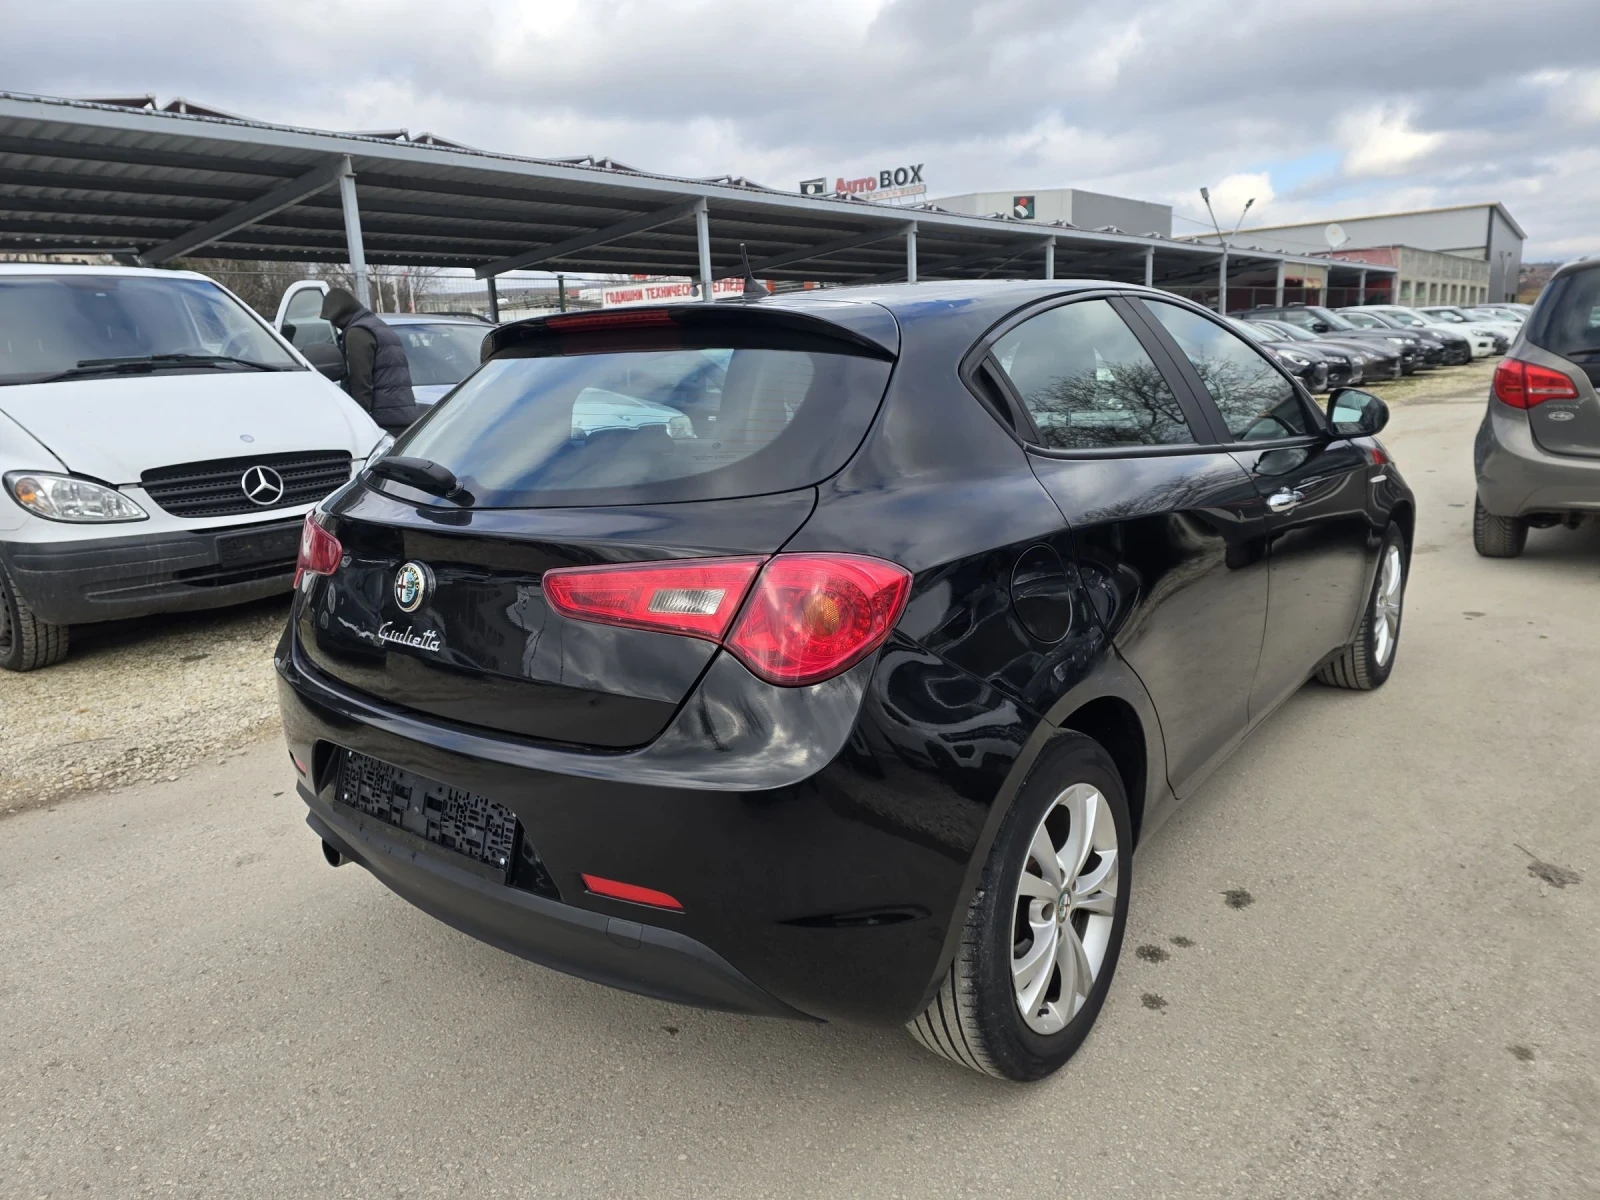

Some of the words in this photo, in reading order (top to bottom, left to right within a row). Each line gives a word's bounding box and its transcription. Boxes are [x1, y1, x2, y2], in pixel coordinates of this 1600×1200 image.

[880, 163, 924, 188] BOX
[605, 288, 643, 305] ГОДИШНИ
[645, 282, 693, 300] ТЕХНИЧЕСК
[378, 621, 441, 652] Giulietta
